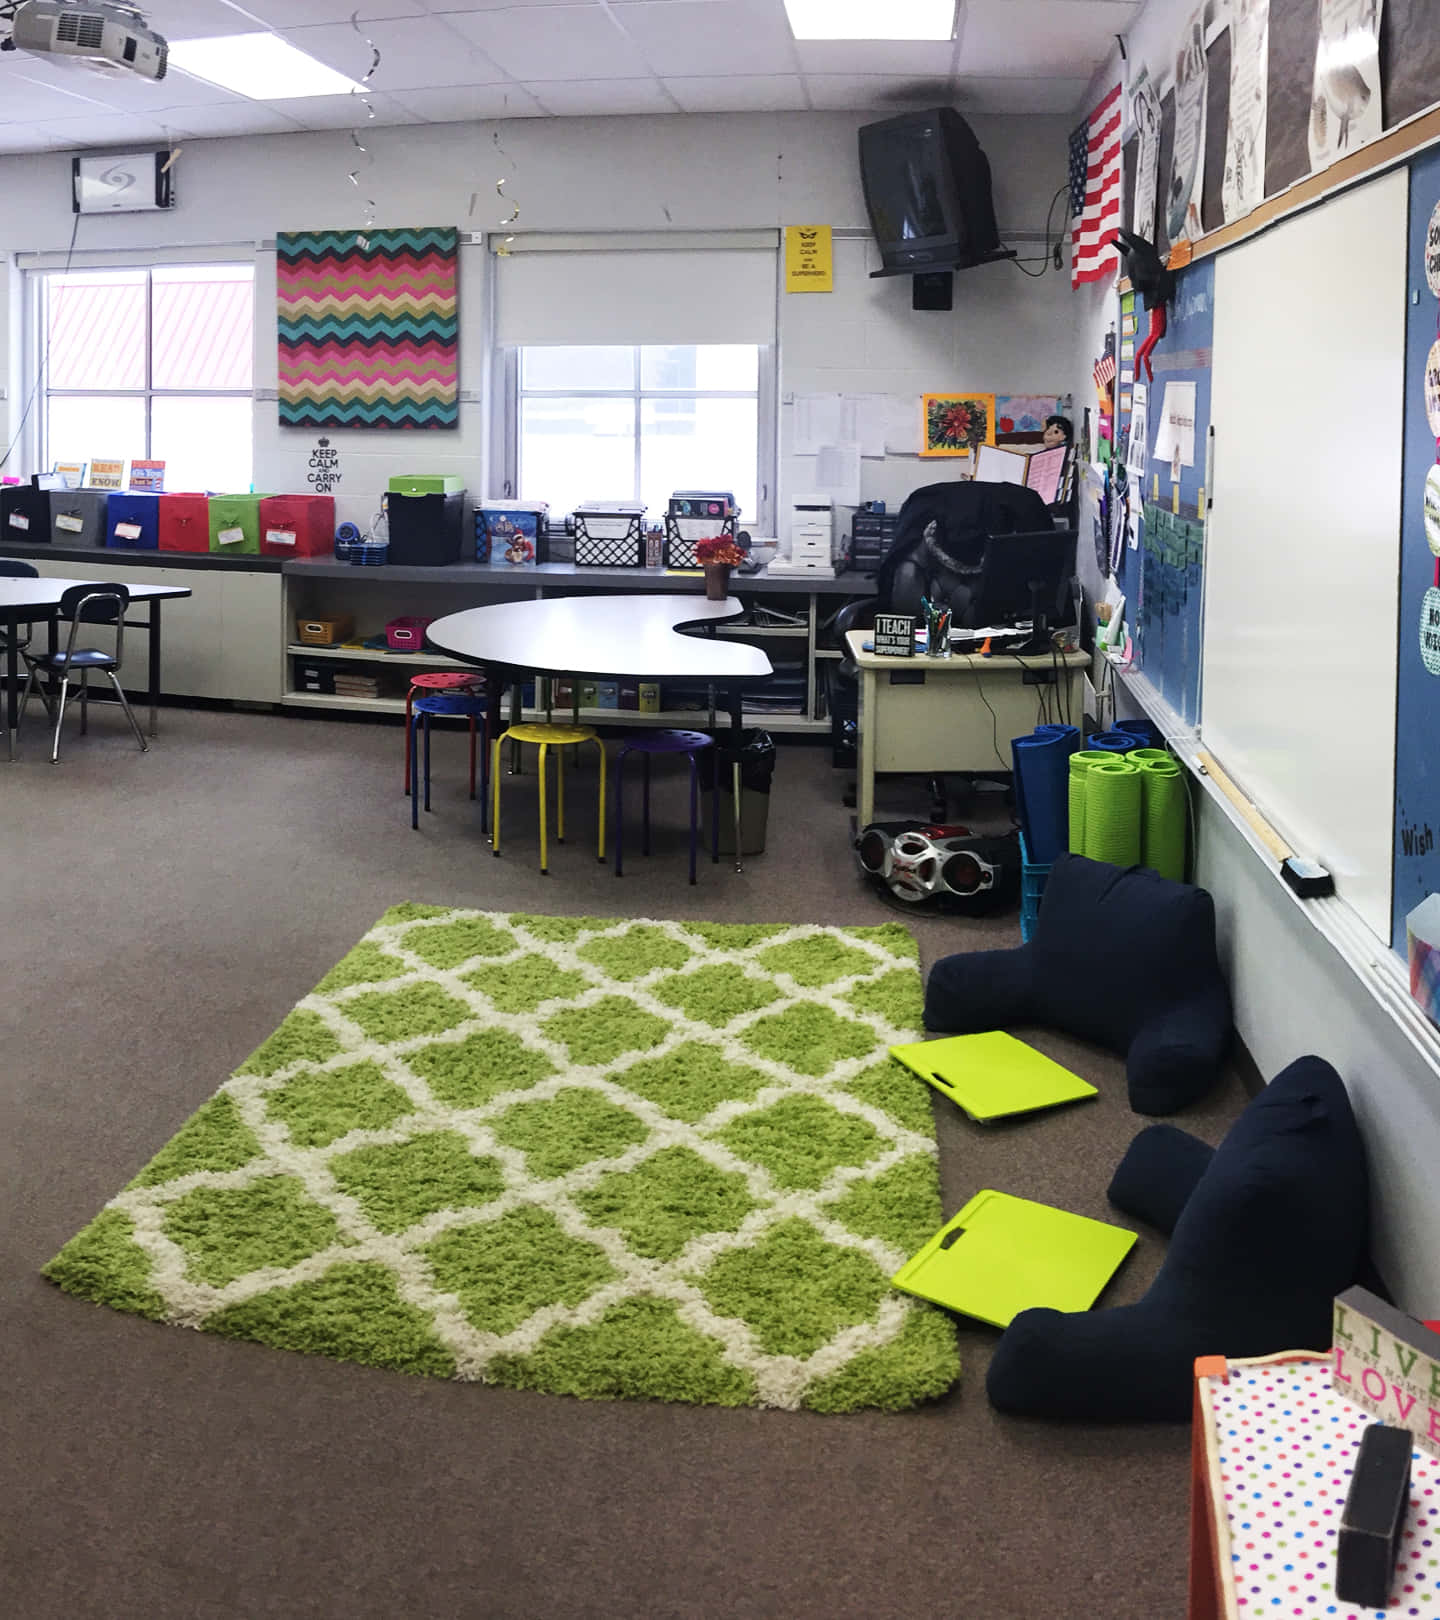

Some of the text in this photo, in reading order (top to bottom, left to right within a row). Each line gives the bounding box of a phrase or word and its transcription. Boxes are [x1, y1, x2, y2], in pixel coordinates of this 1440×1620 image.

[312, 449, 337, 459] KEEP
[308, 458, 338, 469] CALM
[307, 473, 342, 483] CARRY
[315, 482, 332, 493] ON
[876, 618, 910, 635] I TEACH
[1401, 823, 1433, 856] Wish
[1335, 1305, 1440, 1397] LIVE
[1334, 1347, 1440, 1445] LOVE
